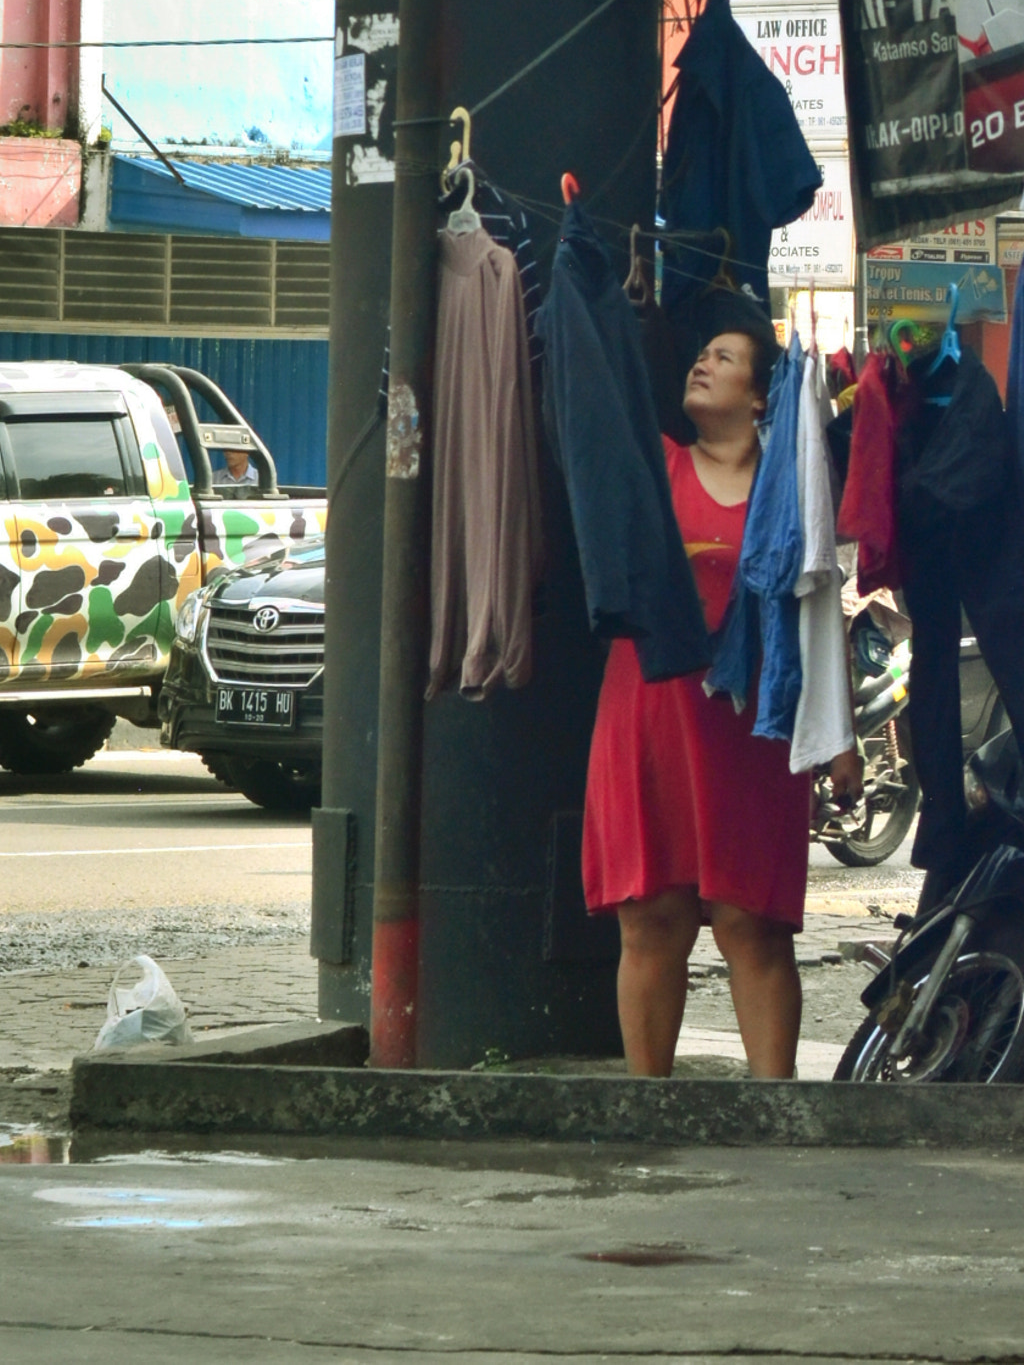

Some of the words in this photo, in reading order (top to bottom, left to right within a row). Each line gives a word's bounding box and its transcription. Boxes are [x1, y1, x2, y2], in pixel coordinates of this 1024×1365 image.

[757, 20, 782, 39] LAW
[786, 18, 828, 38] OFFICE
[873, 38, 927, 63] Katamso
[785, 78, 793, 95] &
[868, 265, 901, 281] Tropy
[219, 690, 234, 711] BK
[241, 691, 268, 713] 1415
